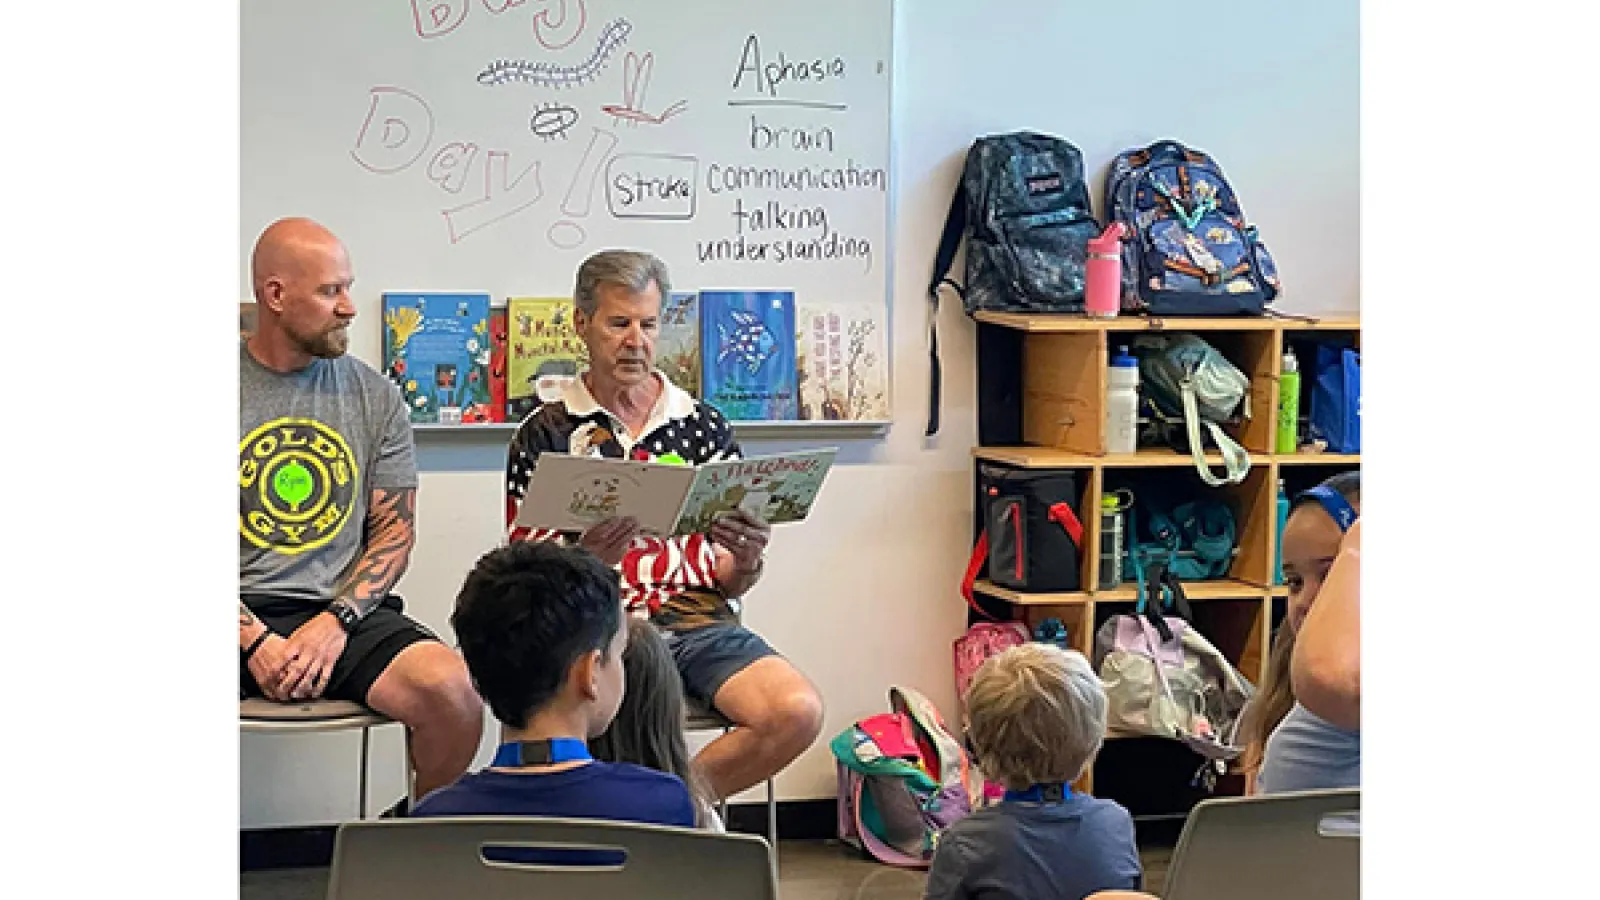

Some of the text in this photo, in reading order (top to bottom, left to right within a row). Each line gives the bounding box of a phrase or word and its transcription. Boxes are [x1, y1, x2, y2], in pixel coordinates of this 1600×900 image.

[732, 33, 846, 97] Aphasia
[750, 112, 834, 152] brain
[731, 198, 830, 241] talking
[696, 231, 873, 276] understanding
[247, 503, 341, 544] GYM
